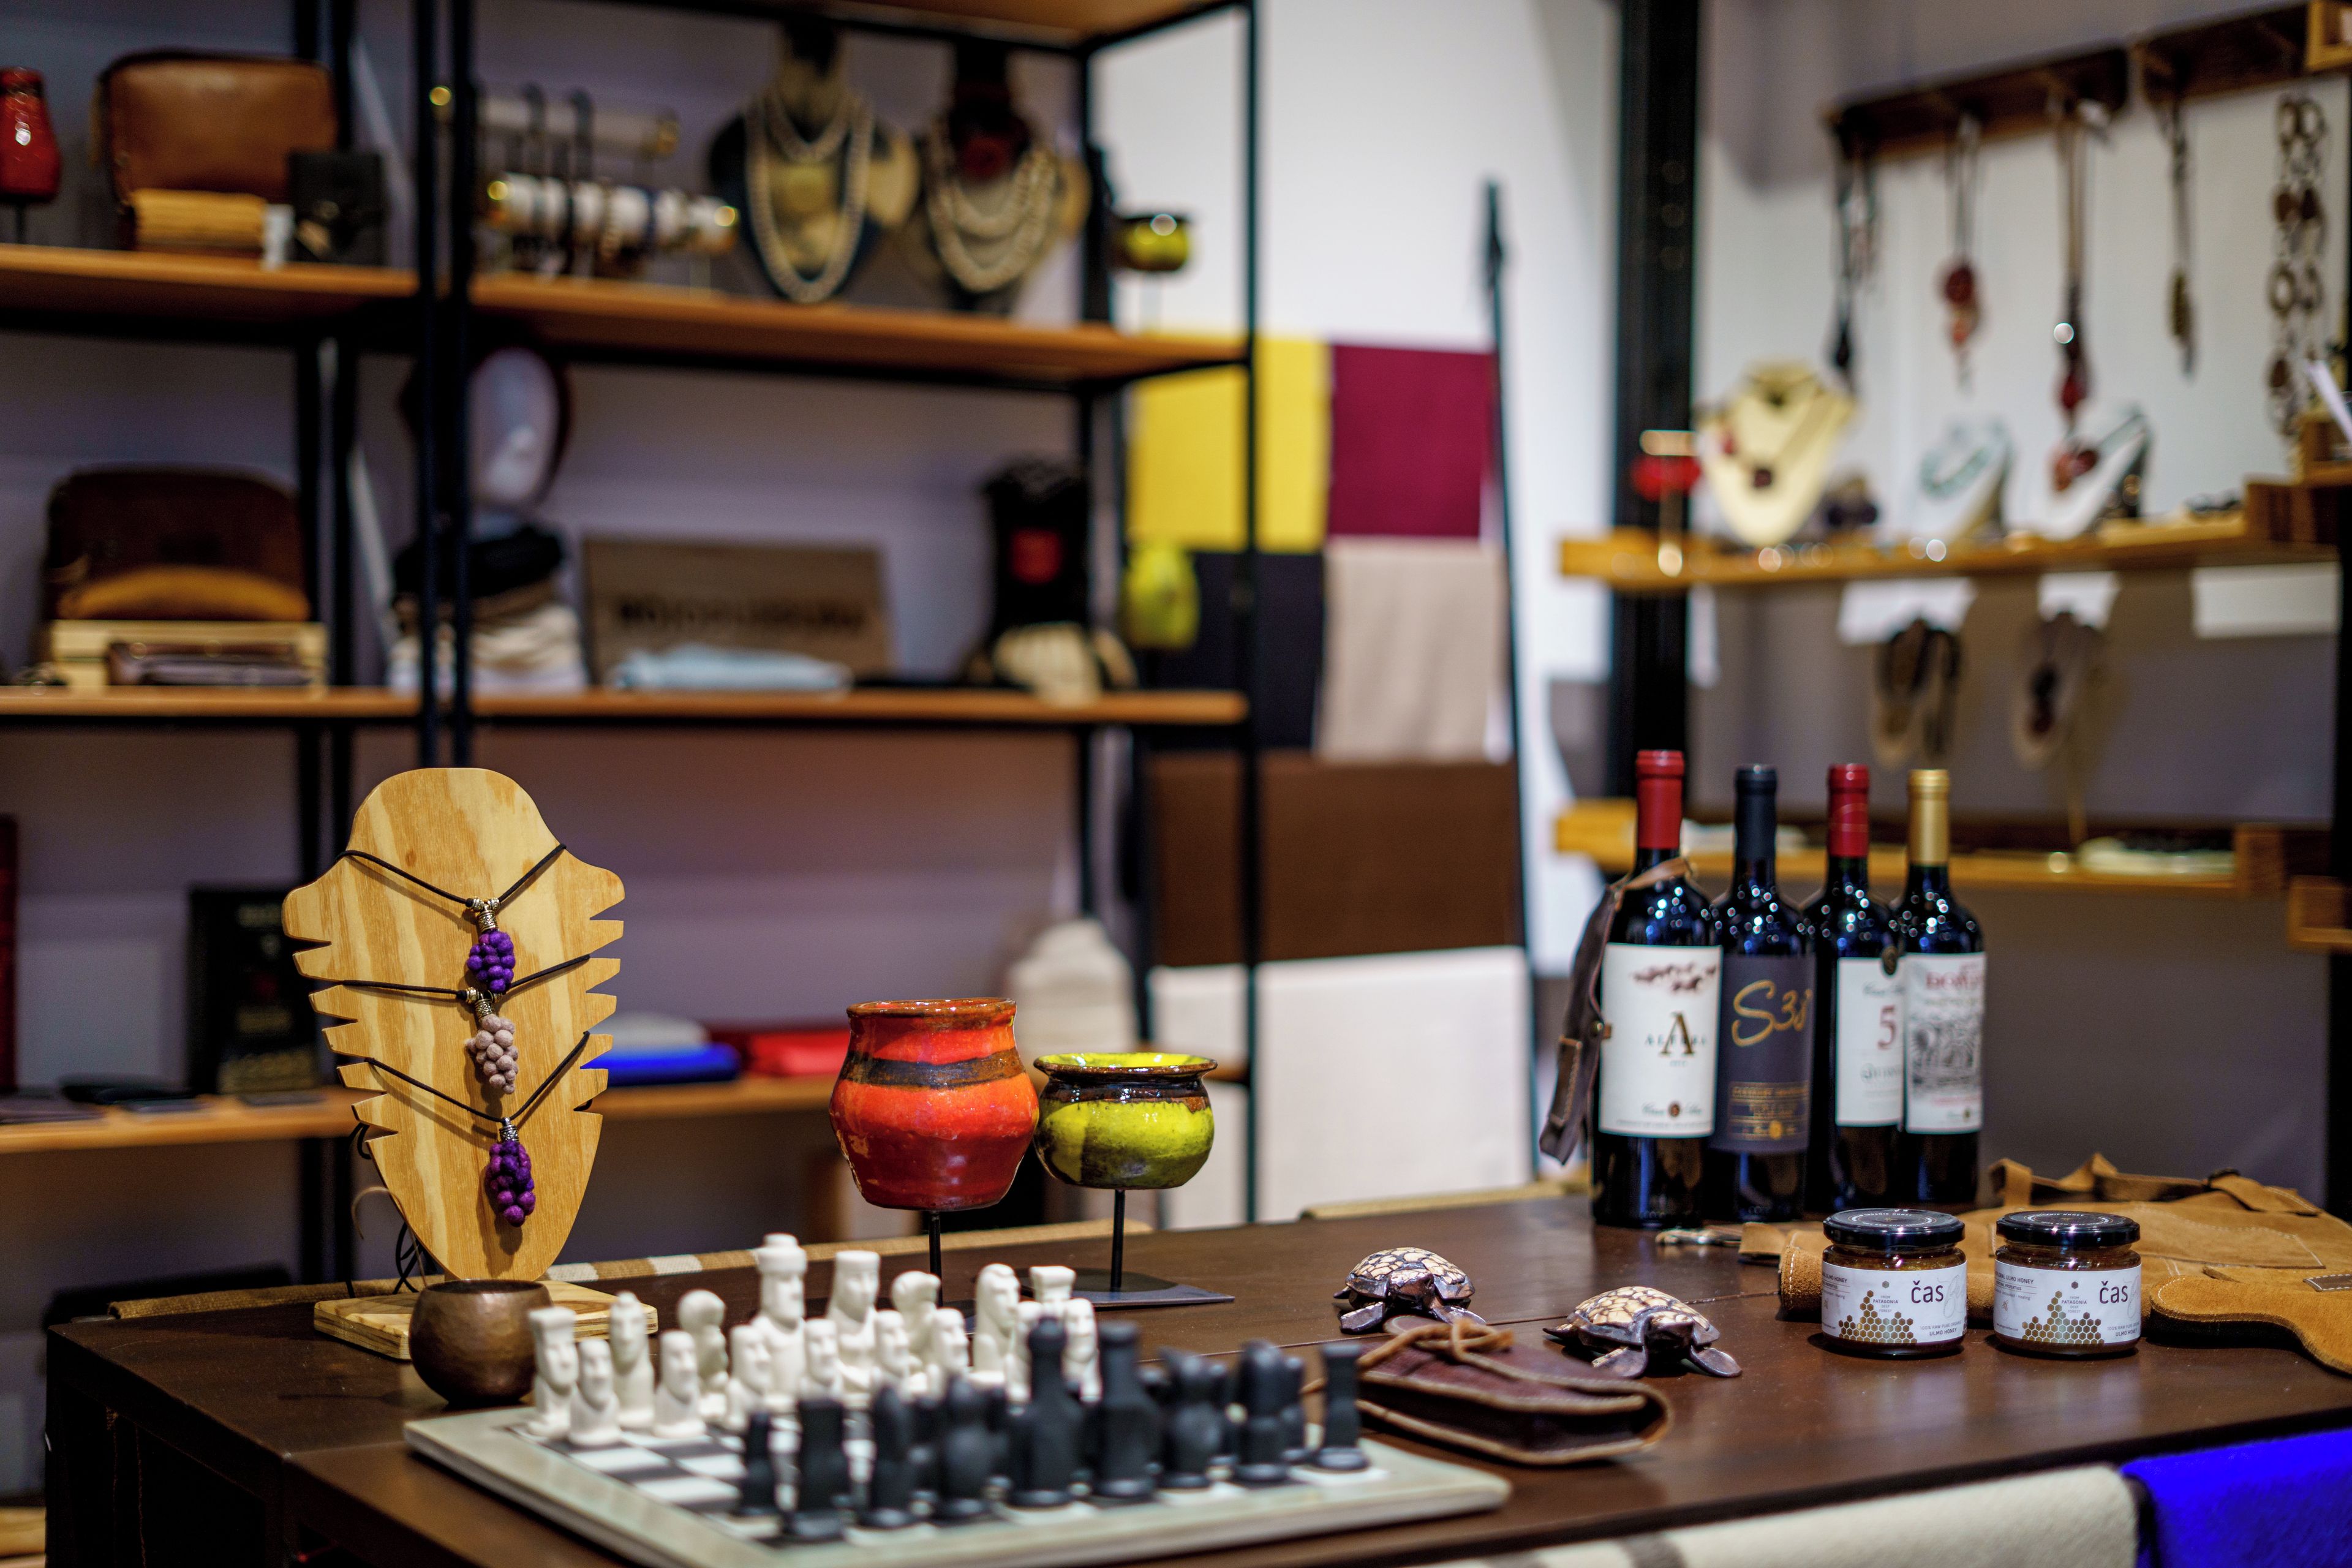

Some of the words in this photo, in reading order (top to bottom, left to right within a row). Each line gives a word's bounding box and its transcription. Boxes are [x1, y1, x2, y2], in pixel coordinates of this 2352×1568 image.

[1659, 1011, 1696, 1056] A
[1877, 1005, 1896, 1050] 5
[1834, 1275, 1848, 1283] HONEY
[1911, 1280, 1944, 1303] čas
[2099, 1280, 2128, 1304] čas
